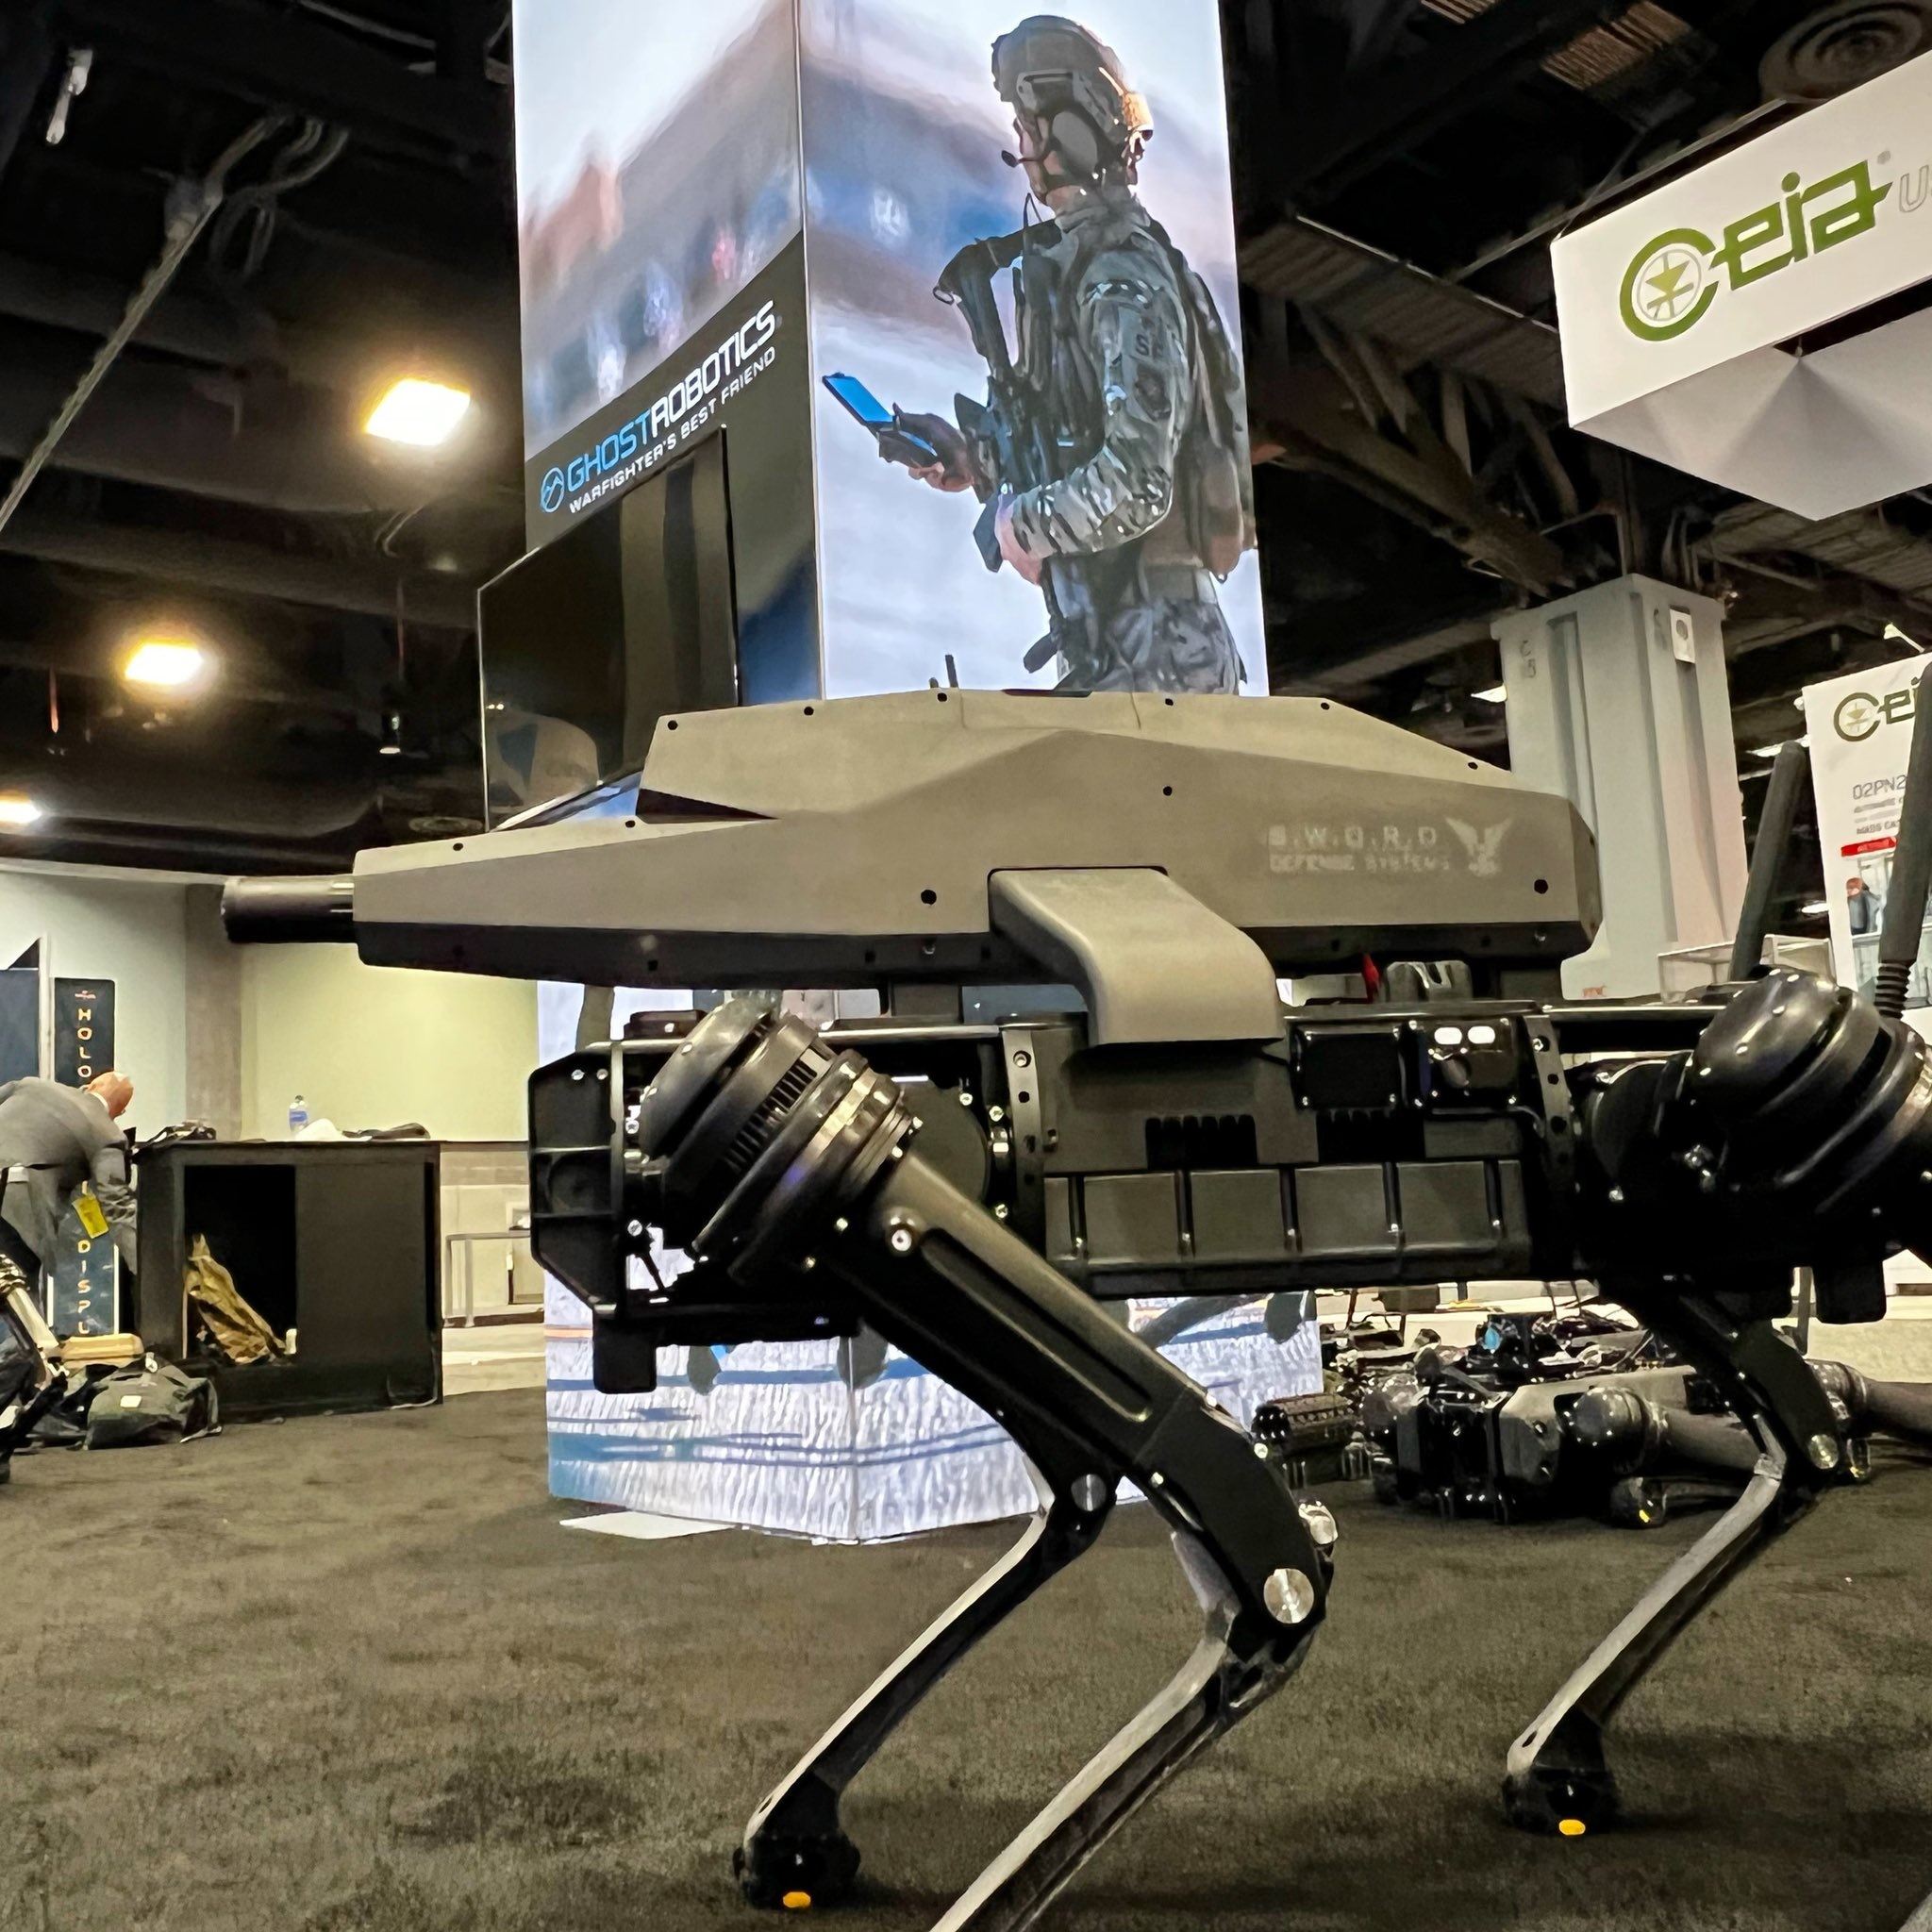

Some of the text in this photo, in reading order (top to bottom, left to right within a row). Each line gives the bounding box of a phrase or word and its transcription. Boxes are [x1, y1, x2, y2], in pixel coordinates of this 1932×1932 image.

[1899, 163, 1932, 213] U
[567, 299, 775, 492] GHOSTROBOTICS
[569, 345, 776, 513] WARFIGHTER'S BEST FRIEND
[1853, 774, 1907, 800] 02PN2
